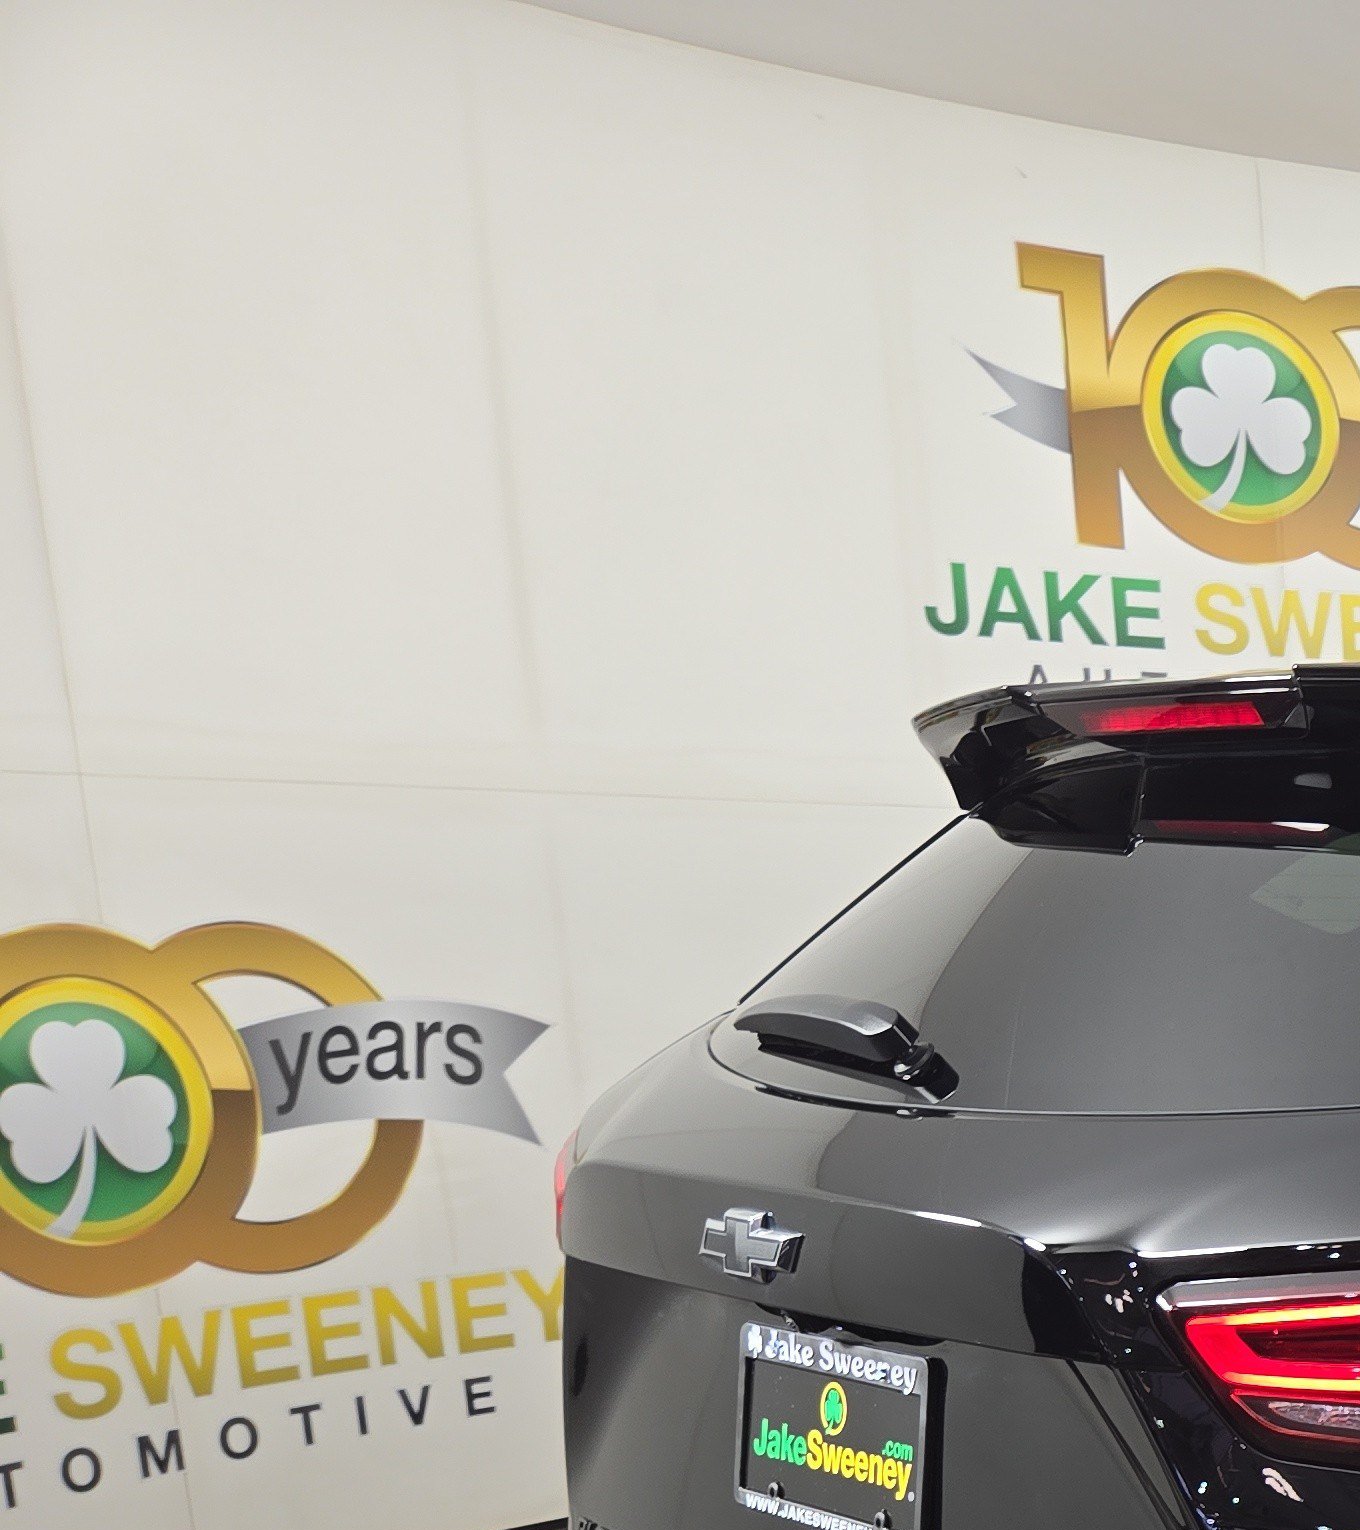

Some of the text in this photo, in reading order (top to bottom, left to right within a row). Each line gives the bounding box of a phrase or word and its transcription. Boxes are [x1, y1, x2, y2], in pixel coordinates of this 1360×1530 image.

[924, 562, 1166, 649] JAKE
[0, 920, 424, 1298] 00
[268, 1019, 483, 1115] years
[51, 1265, 566, 1420] SWEENEY
[765, 1326, 917, 1395] Jake Sweeney
[0, 1375, 497, 1509] TOMOTIVE
